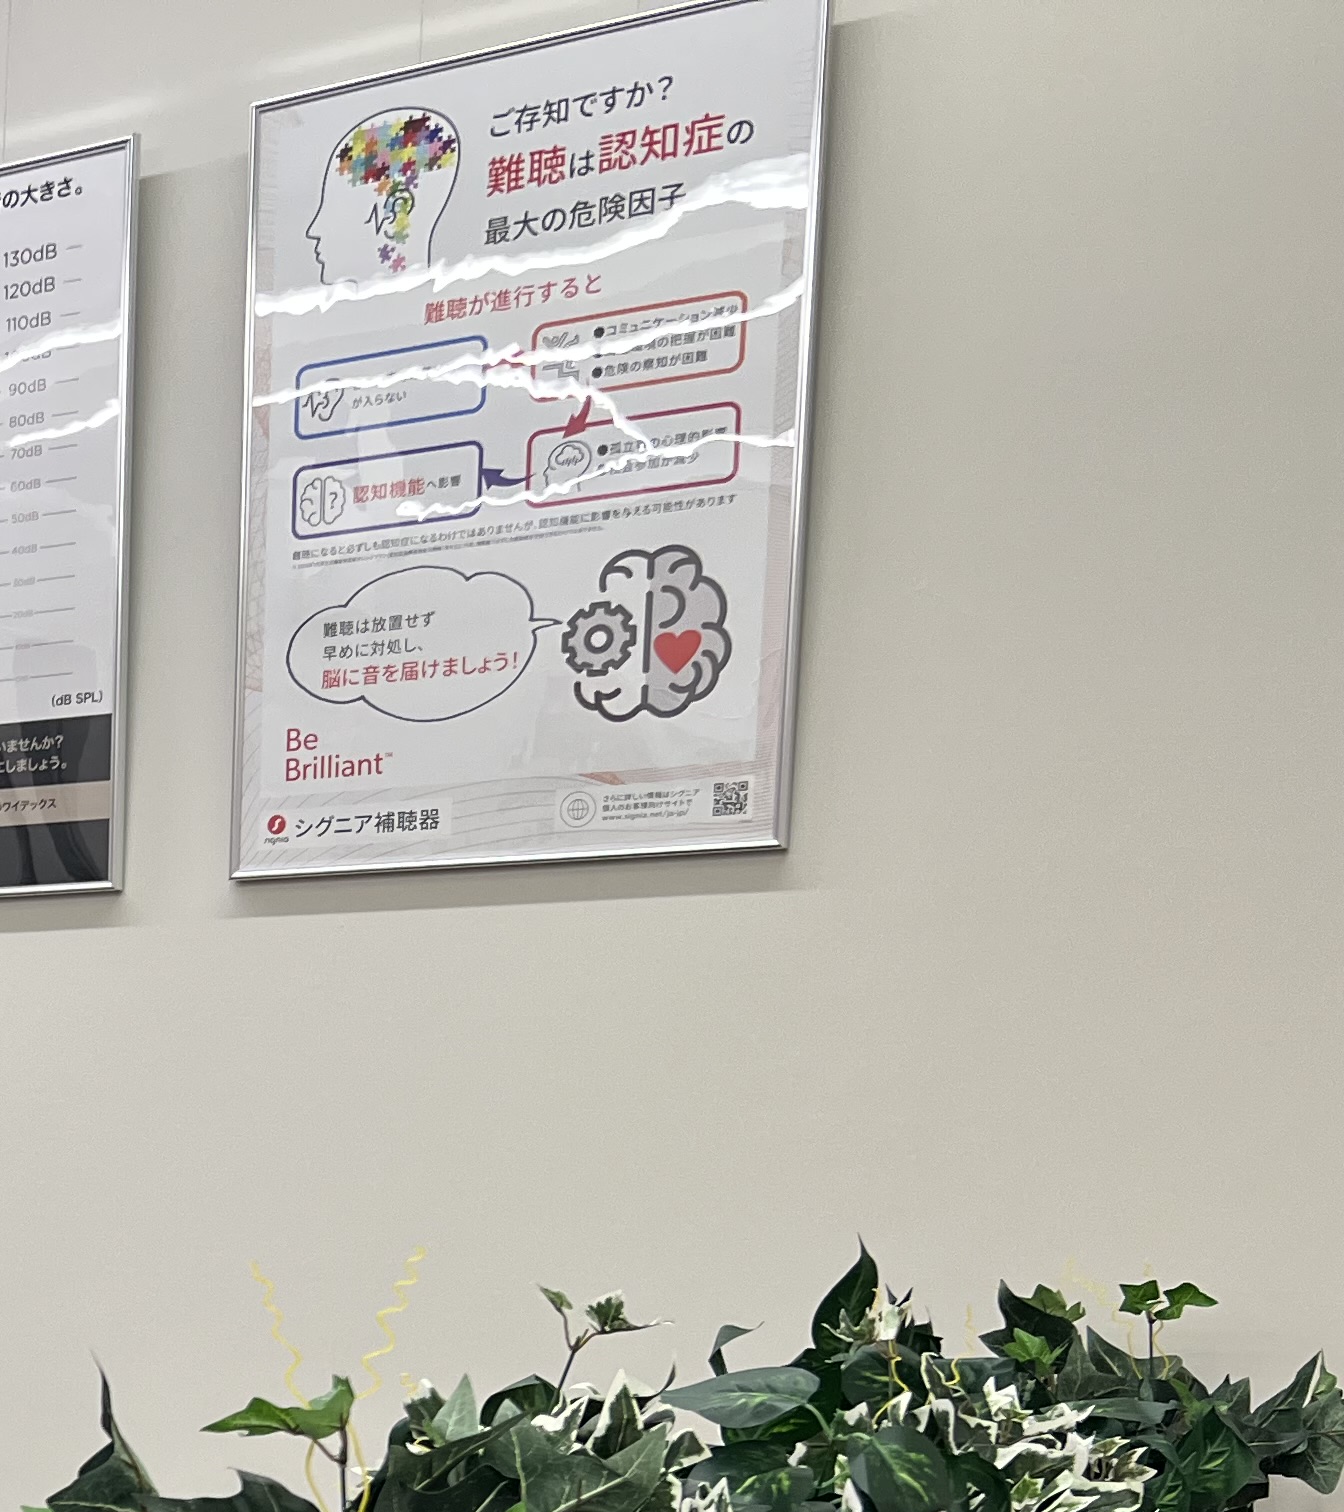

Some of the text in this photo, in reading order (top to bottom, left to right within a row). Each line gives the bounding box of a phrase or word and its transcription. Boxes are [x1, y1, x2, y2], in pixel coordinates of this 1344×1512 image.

[489, 76, 675, 139] ご存知ですか？
[486, 112, 755, 198] 難聴は認知症の
[484, 182, 687, 246] 最大の危険因子
[3, 242, 58, 269] 130dB
[3, 277, 56, 301] 120dB
[424, 273, 603, 326] 難聴が進行すると
[5, 310, 52, 333] 110dB
[9, 378, 46, 396] 90dB
[9, 411, 45, 428] 80dB
[10, 444, 43, 460] 70dB
[10, 478, 42, 493] 60dB
[352, 473, 462, 505] 認知機能へ影響
[11, 511, 39, 524] 50dB
[322, 611, 436, 639] 難聴は放置せず
[321, 637, 425, 662] 早めに対処し、
[51, 690, 103, 709] (dB SPL)
[285, 727, 319, 753] Be
[295, 808, 440, 838] シグニア補聴器
